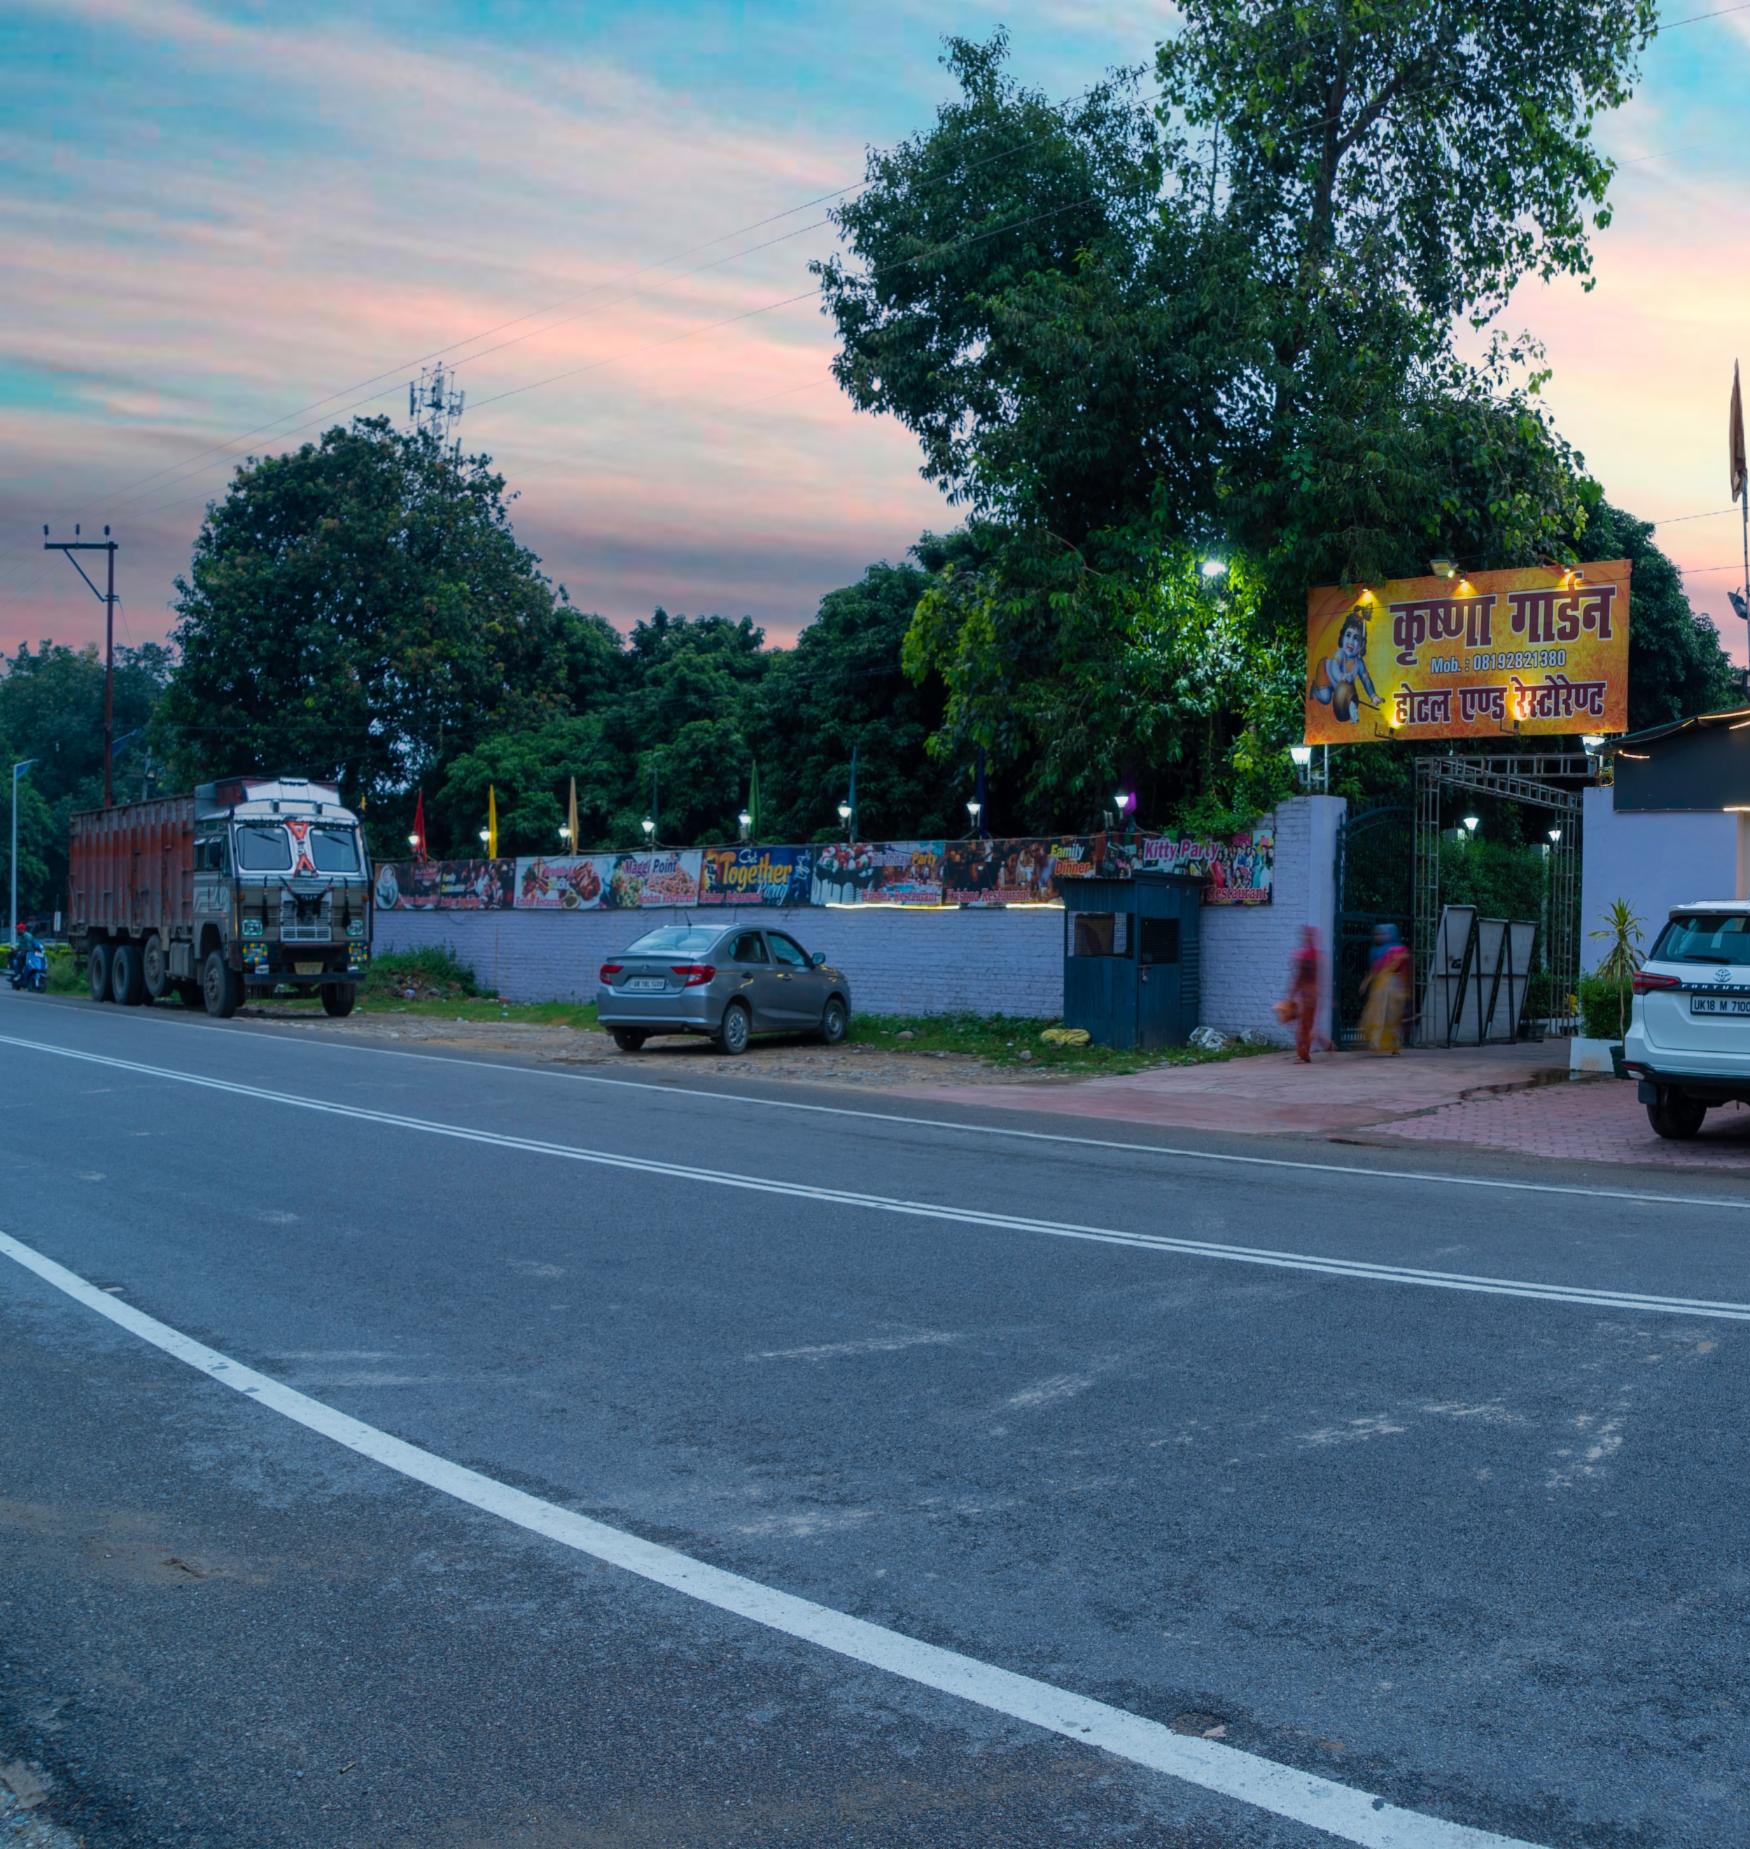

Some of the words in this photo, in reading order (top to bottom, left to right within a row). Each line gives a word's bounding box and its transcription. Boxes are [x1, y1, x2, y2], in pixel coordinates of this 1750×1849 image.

[1389, 594, 1497, 666] कृष्णा
[1472, 650, 1566, 671] 08192821380
[1394, 683, 1453, 724] होटल
[1458, 686, 1508, 722] एण्ड
[1051, 842, 1086, 861] Family
[1143, 838, 1178, 862] Kitty
[1179, 838, 1221, 864] Party
[623, 859, 650, 874] Maggi
[652, 858, 678, 874] Point
[719, 851, 793, 892] Together
[1055, 860, 1091, 876] Dinner
[1694, 999, 1716, 1011] UK18
[1719, 1000, 1728, 1011] M
